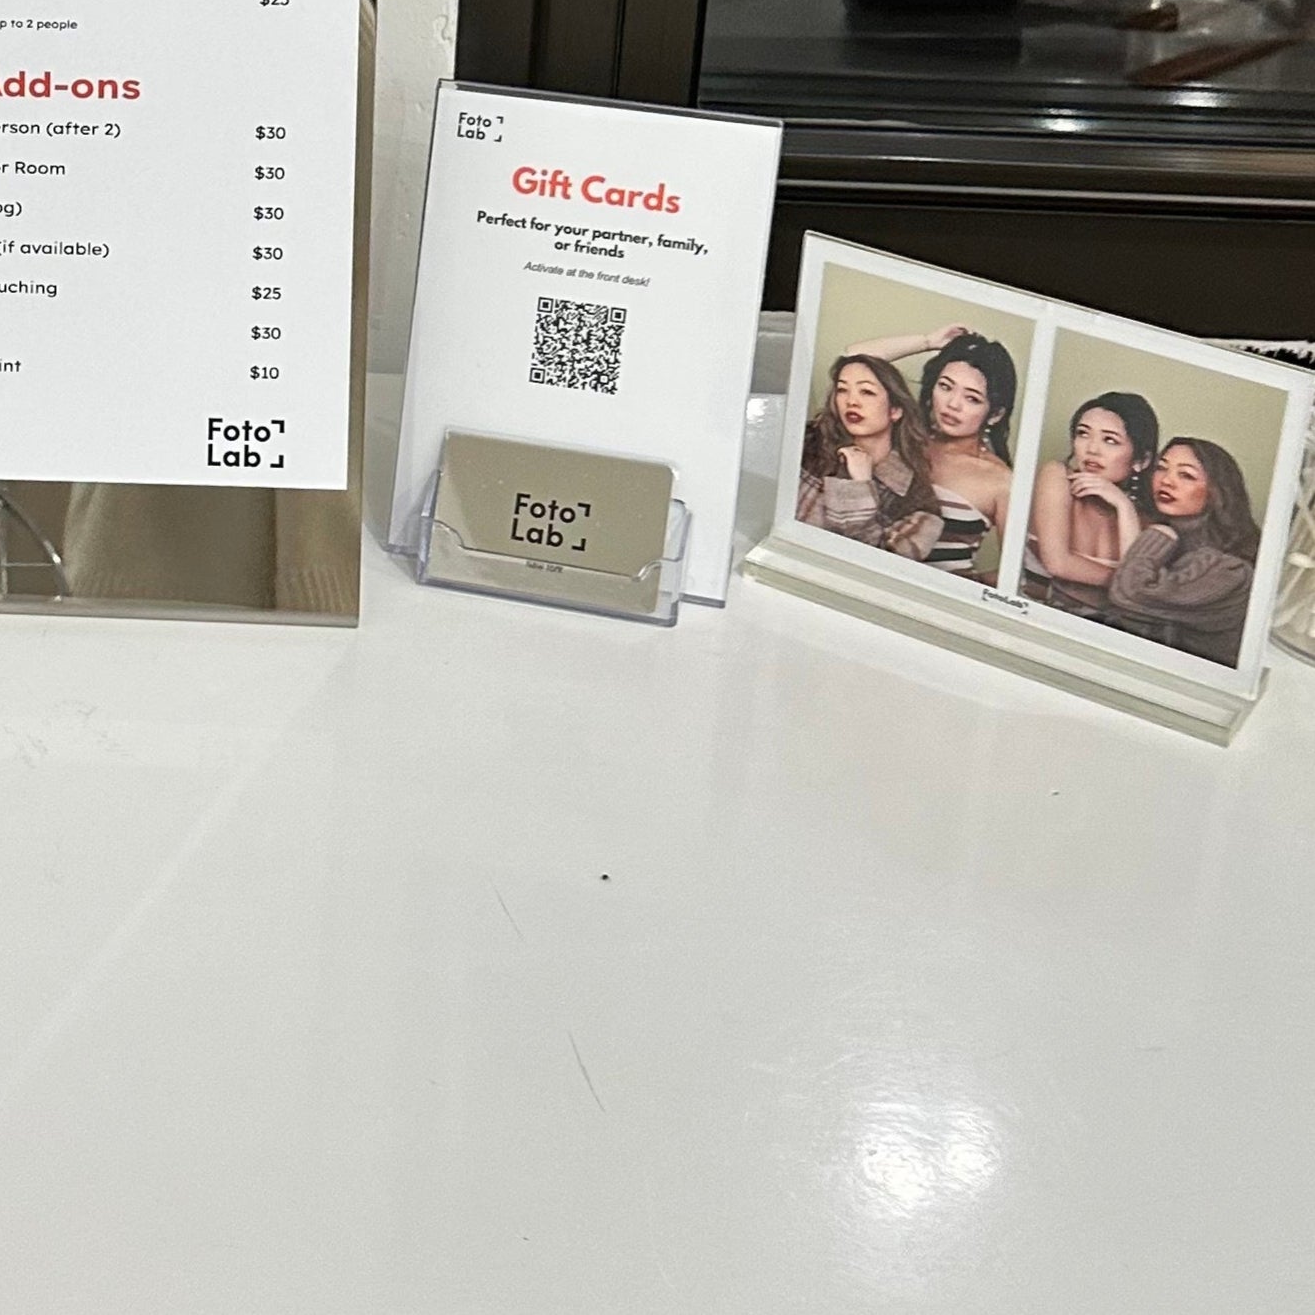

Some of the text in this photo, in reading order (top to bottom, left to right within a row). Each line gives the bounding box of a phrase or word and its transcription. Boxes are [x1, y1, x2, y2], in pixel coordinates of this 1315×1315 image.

[10, 19, 24, 29] to
[26, 19, 34, 29] 2
[36, 19, 78, 32] people
[458, 112, 492, 128] Foto
[47, 122, 99, 137] (after
[105, 124, 120, 138] 2)
[256, 126, 285, 140] $30
[457, 125, 486, 140] Lab
[14, 161, 66, 175] Room
[255, 166, 285, 180] $30
[513, 167, 680, 213] Gift Cards
[254, 206, 284, 220] $30
[477, 211, 708, 255] Perfect for your partner, family,
[20, 242, 109, 258] available)
[253, 246, 283, 260] $30
[554, 240, 624, 258] or friends
[522, 261, 651, 288] Activate at the front desk!
[252, 286, 281, 300] $25
[252, 326, 281, 340] $30
[250, 366, 279, 380] $10
[208, 418, 270, 442] Foto
[208, 444, 261, 467] Lab
[514, 493, 576, 523] Foto
[511, 518, 564, 547] Lab
